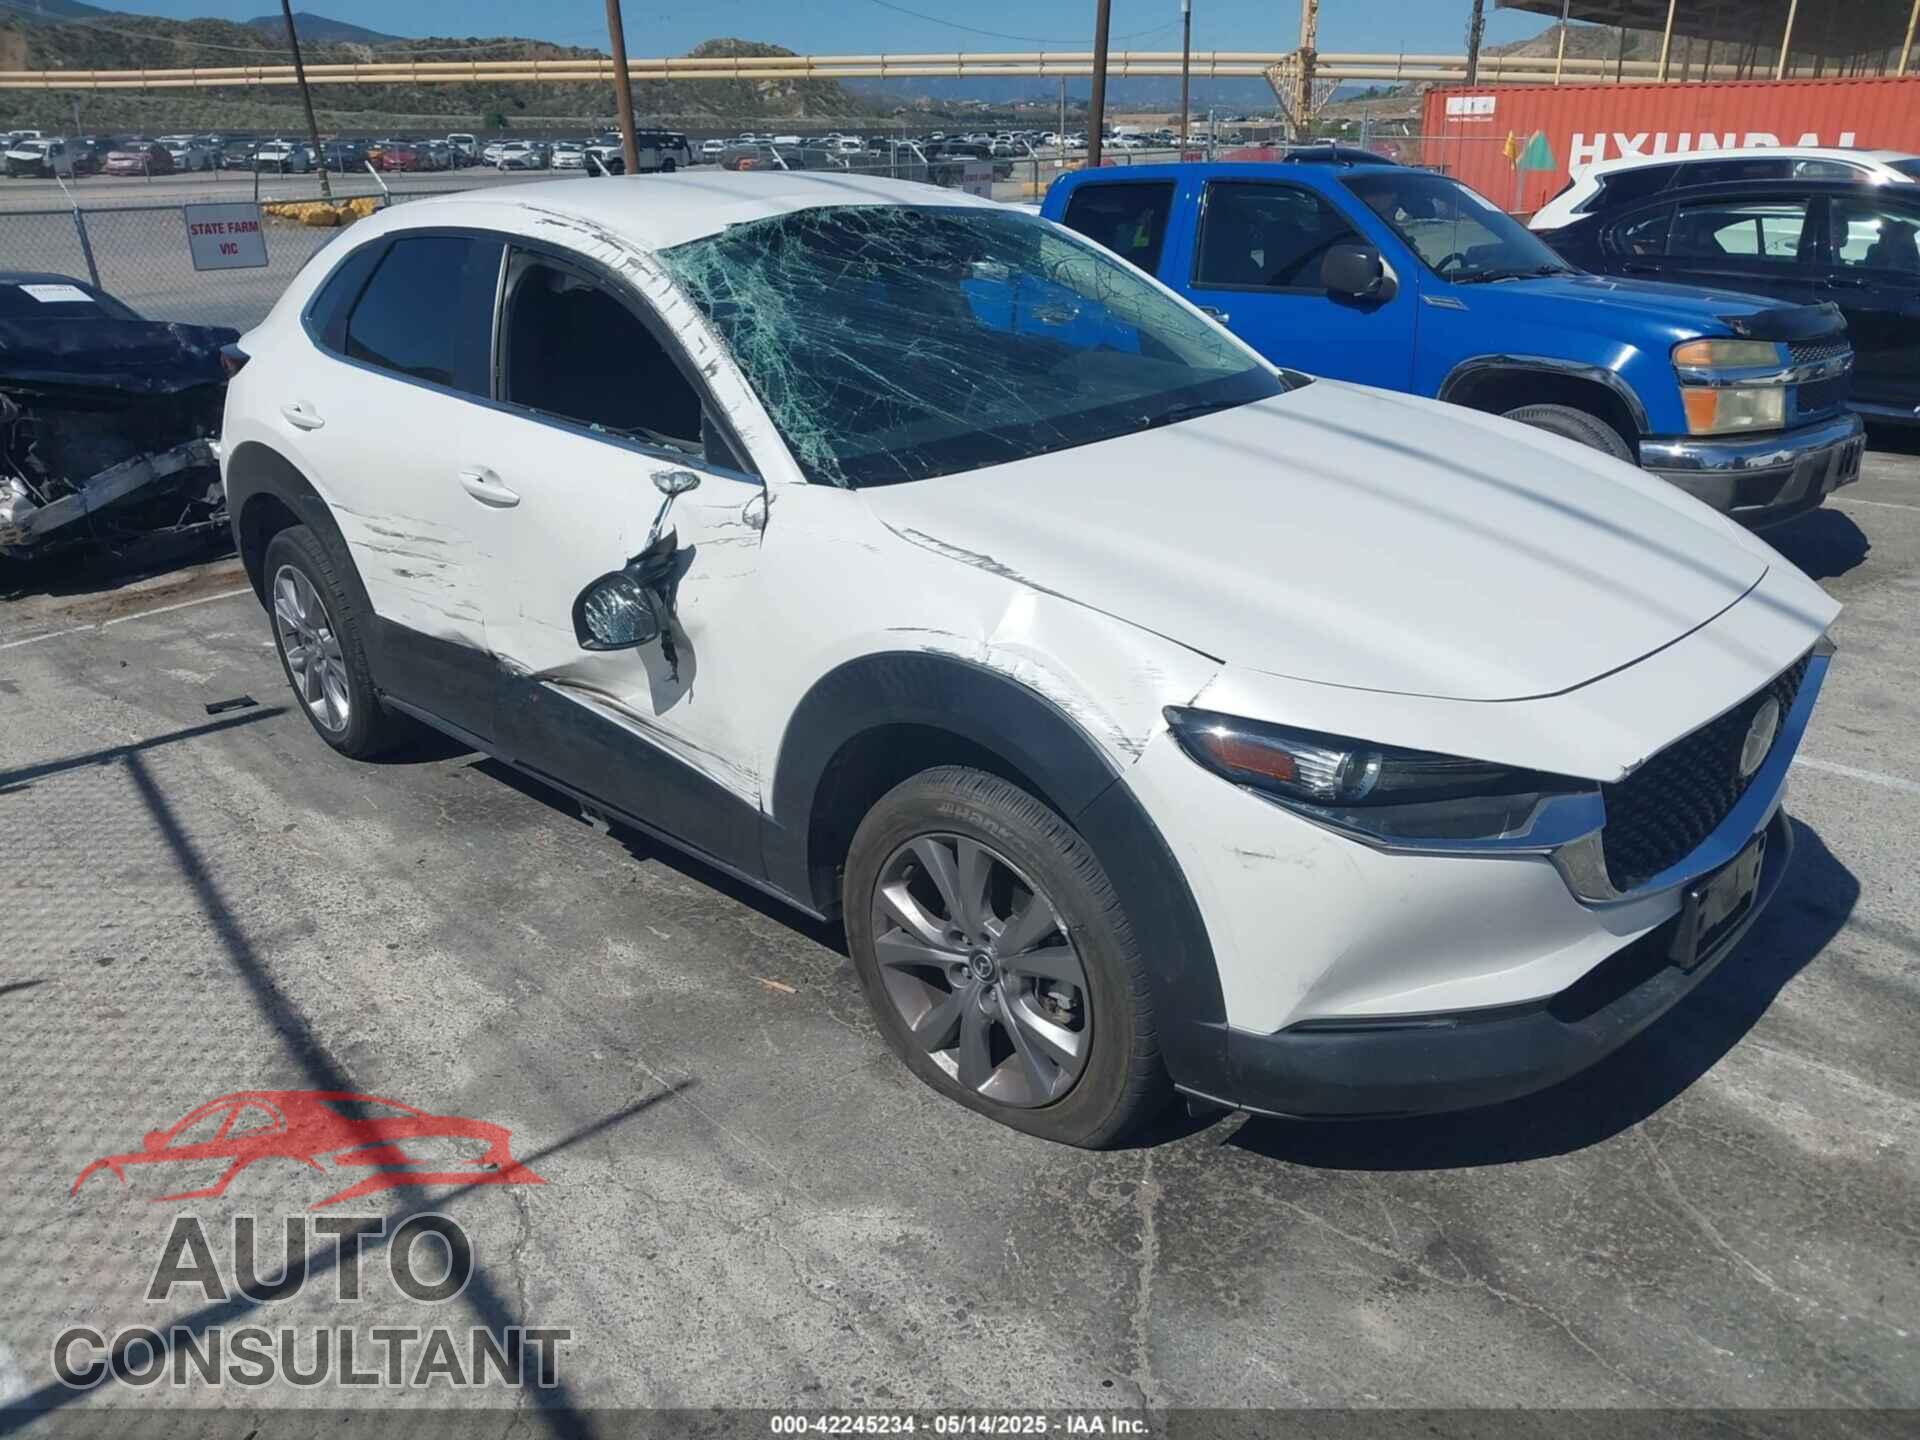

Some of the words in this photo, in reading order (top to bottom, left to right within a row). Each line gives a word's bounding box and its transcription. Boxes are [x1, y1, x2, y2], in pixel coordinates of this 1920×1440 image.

[191, 222, 224, 235] STATE
[228, 220, 259, 233] FARM
[219, 242, 238, 255] VIC
